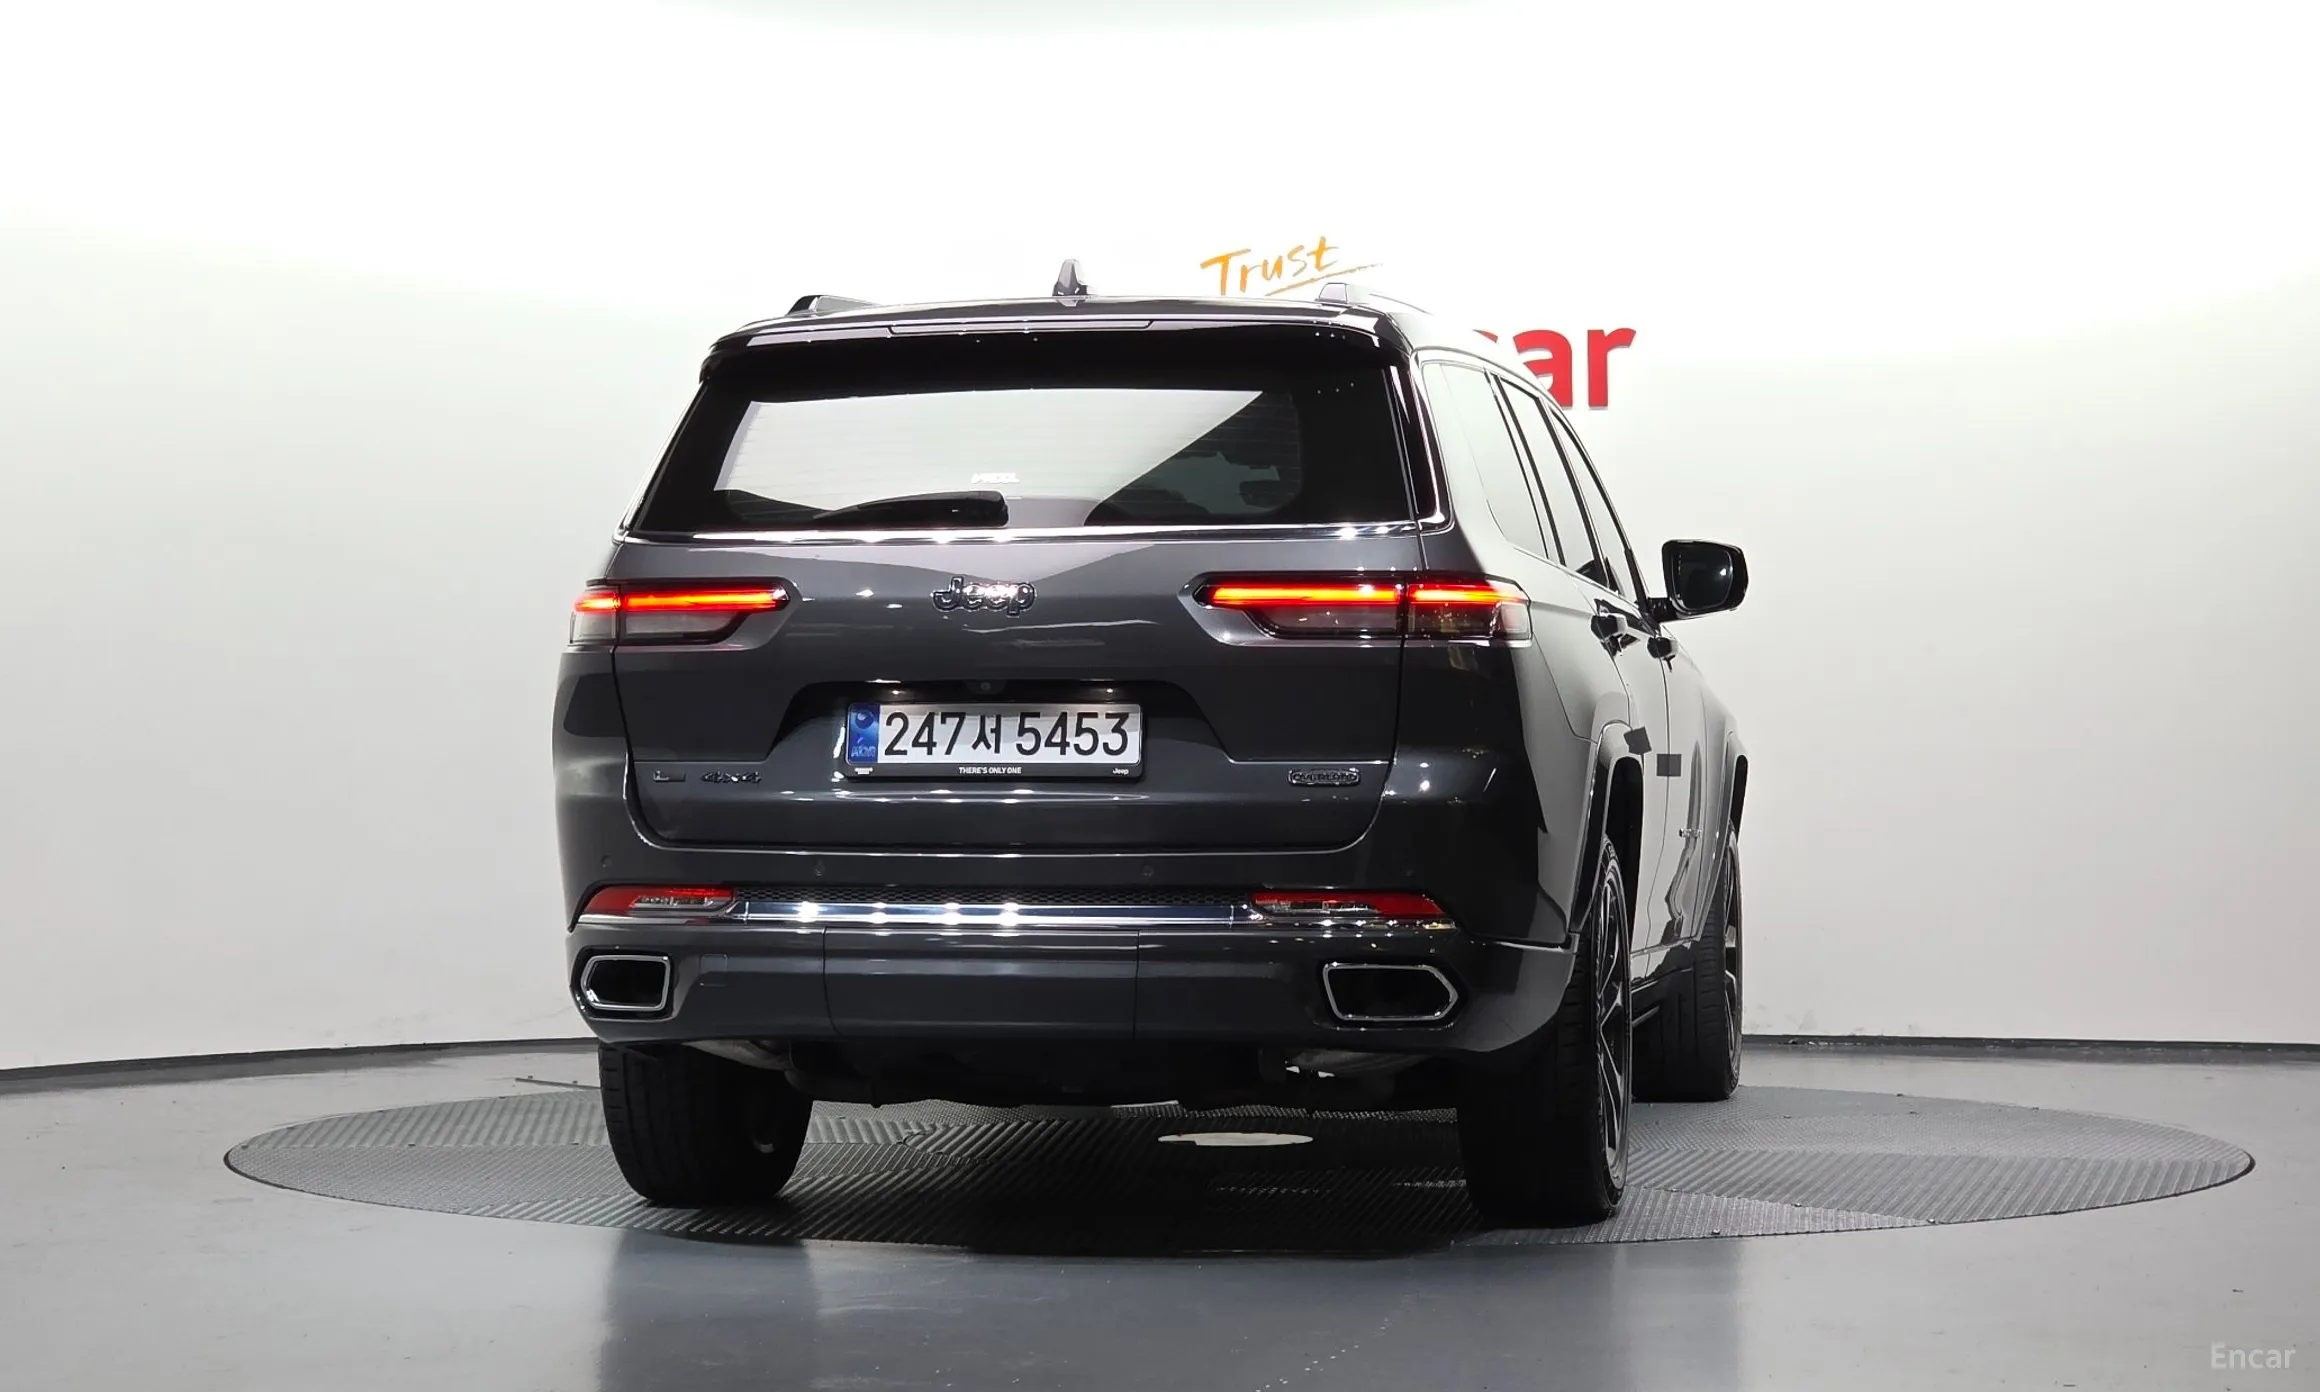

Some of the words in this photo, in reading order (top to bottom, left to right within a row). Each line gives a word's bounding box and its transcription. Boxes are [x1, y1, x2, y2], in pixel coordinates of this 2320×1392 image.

[1200, 236, 1339, 295] Trust
[1472, 327, 1636, 410] ar
[931, 575, 1036, 617] Jeep
[884, 711, 1002, 756] 247서
[1015, 711, 1129, 756] 5453
[958, 766, 988, 774] THERE'S
[988, 766, 1007, 774] ONLY
[1006, 766, 1022, 774] ONE
[1112, 767, 1130, 776] Jeep
